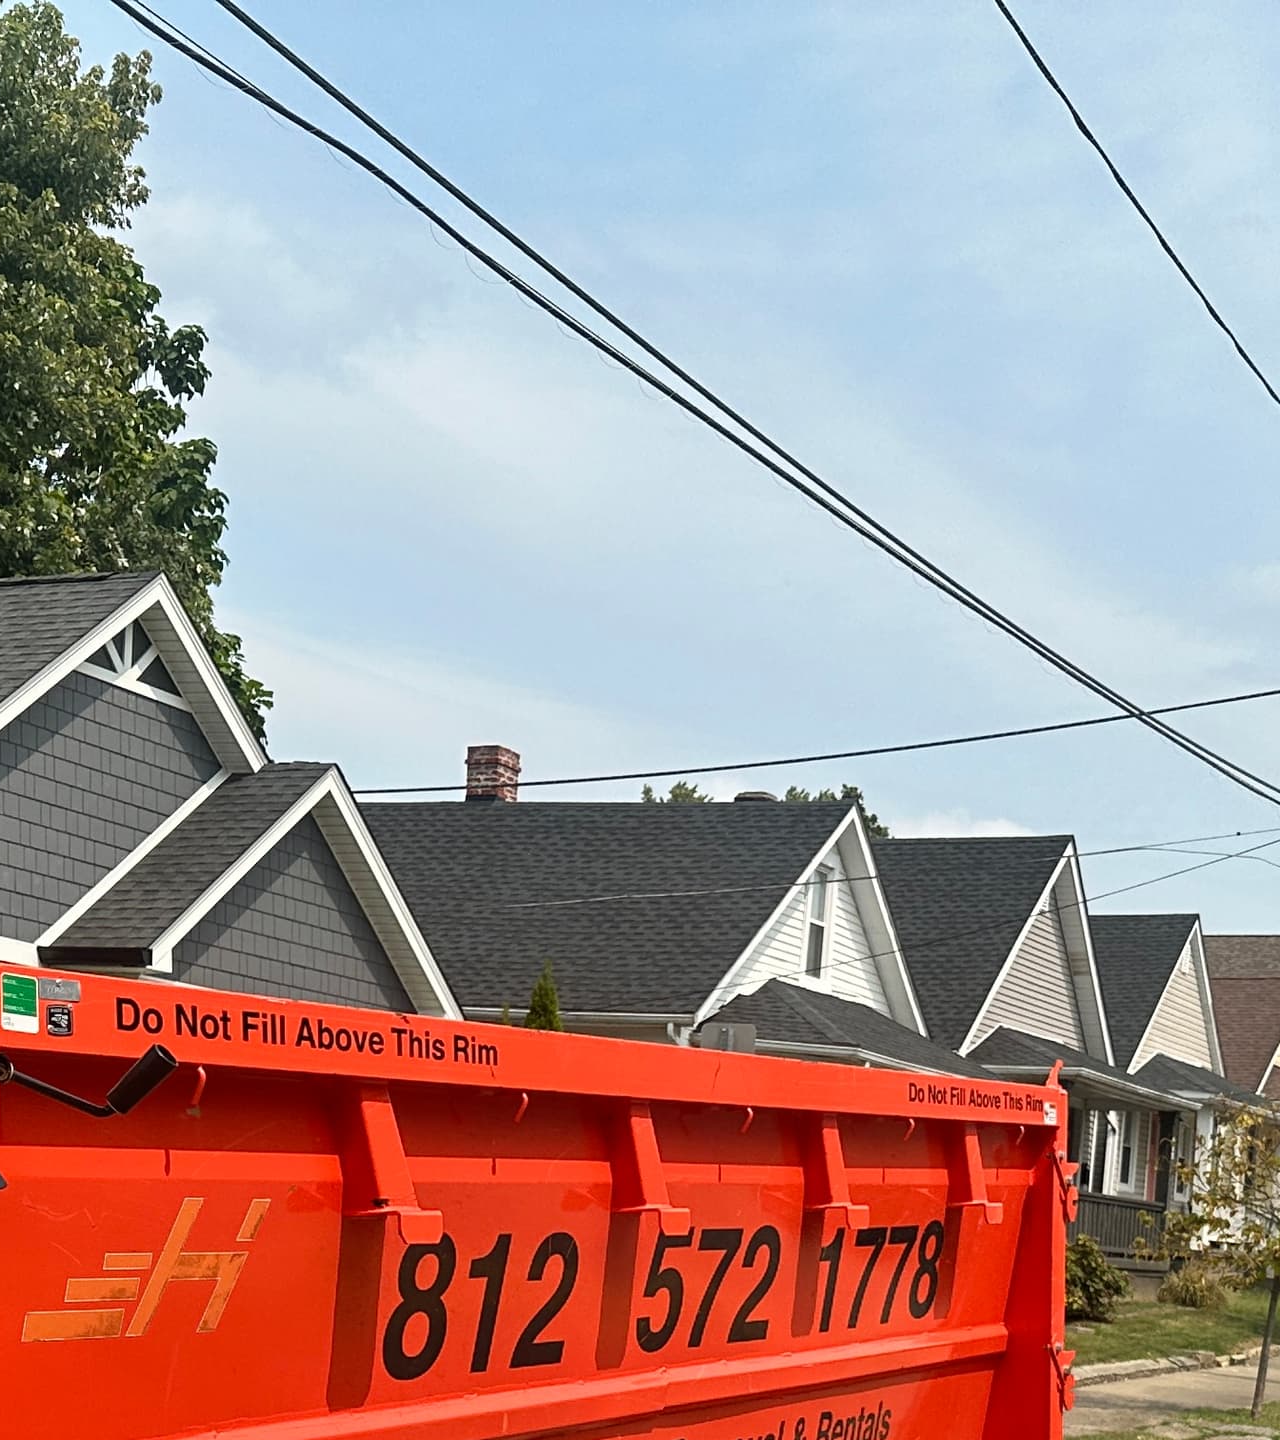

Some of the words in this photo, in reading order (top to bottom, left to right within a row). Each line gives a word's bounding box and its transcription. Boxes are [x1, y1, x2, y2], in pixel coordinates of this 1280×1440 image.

[115, 997, 164, 1034] Do
[175, 1003, 233, 1042] Not
[241, 1011, 286, 1046] Fill
[295, 1016, 385, 1055] Above
[390, 1026, 446, 1061] This
[452, 1034, 498, 1067] Rim
[909, 1082, 925, 1103] Do
[927, 1083, 948, 1105] Not
[950, 1086, 966, 1106] Fill
[968, 1089, 1001, 1110] Above
[1002, 1091, 1024, 1112] This
[1025, 1094, 1043, 1113] Rim
[382, 1231, 580, 1381] 812
[636, 1225, 781, 1353] 572
[819, 1219, 945, 1333] 1778
